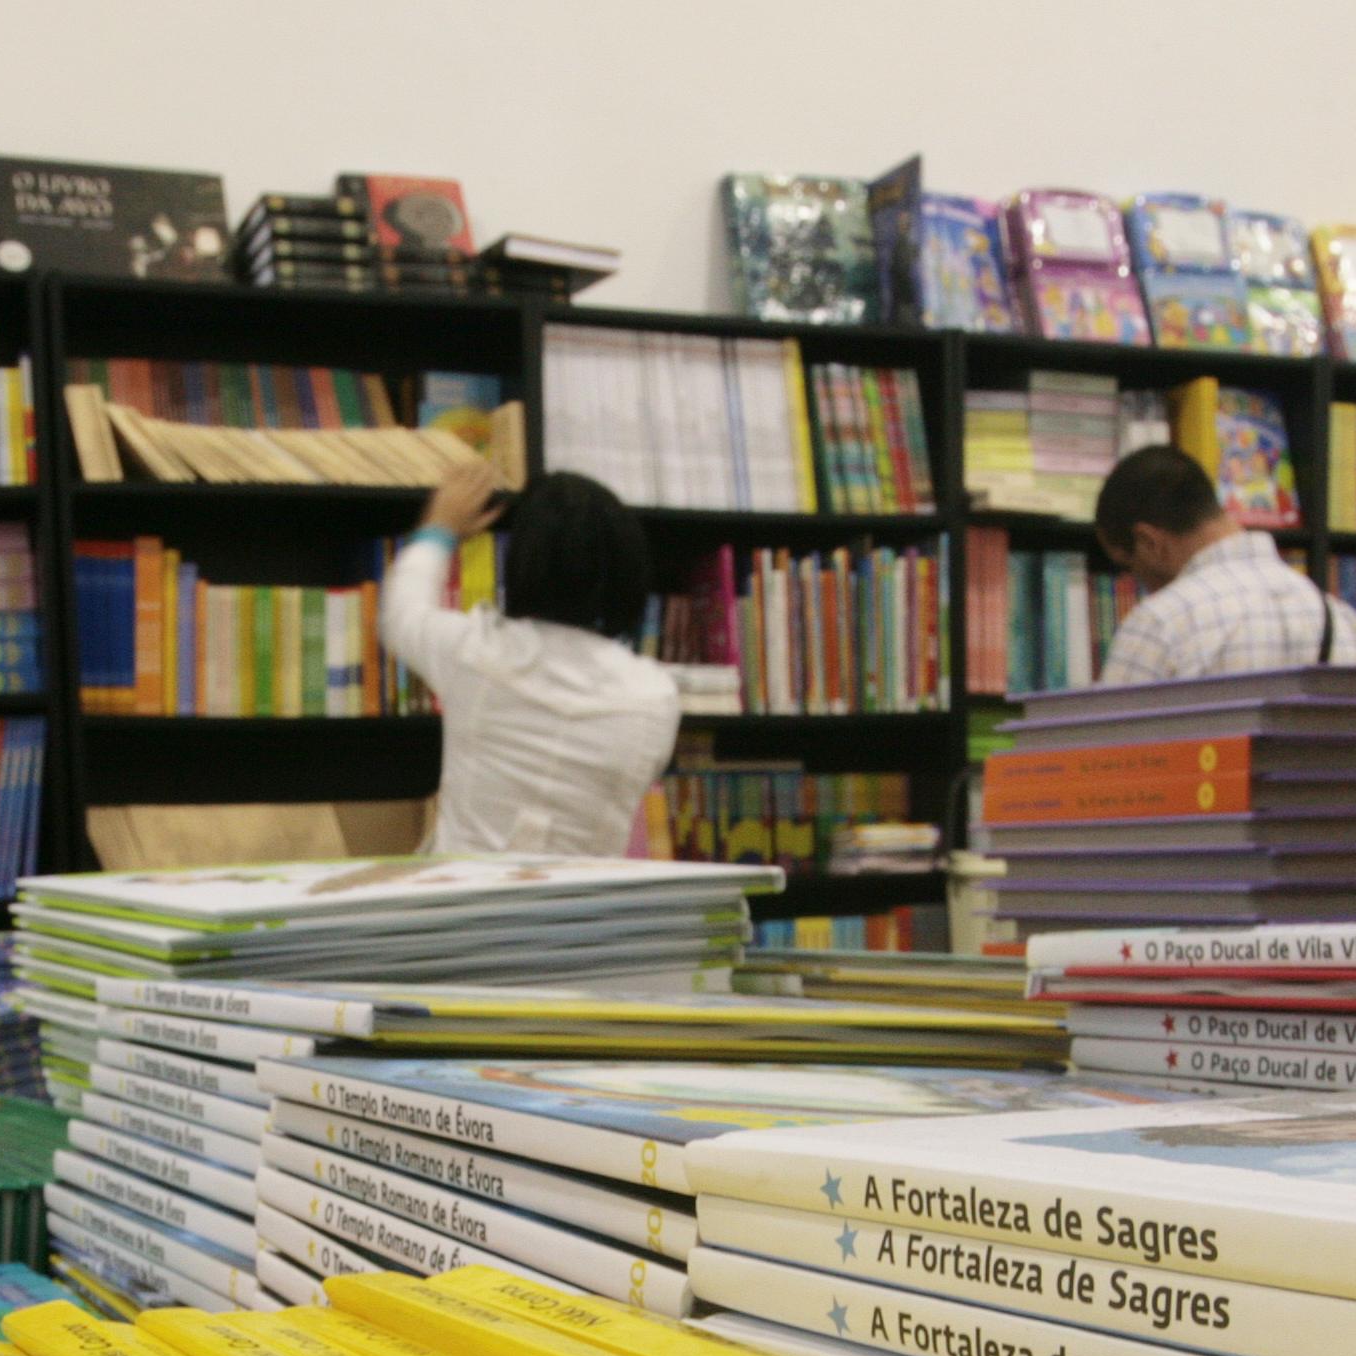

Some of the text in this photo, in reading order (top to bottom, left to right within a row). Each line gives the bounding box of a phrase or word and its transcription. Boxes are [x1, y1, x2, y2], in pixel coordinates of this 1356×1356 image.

[1144, 938, 1161, 963] O
[1165, 939, 1205, 969] Paço
[1212, 937, 1262, 963] Ducal
[1267, 937, 1291, 962] de
[1296, 935, 1334, 961] Vila
[1187, 1015, 1203, 1037] O
[1207, 1016, 1247, 1045] Paço
[1256, 1018, 1304, 1046] Ducal
[1313, 1021, 1338, 1047] de
[1190, 1050, 1206, 1074] O
[1210, 1052, 1248, 1082] Paço
[1257, 1055, 1305, 1082] Ducal
[1313, 1058, 1338, 1084] de
[327, 1083, 494, 1143] O Templo Romano de Évora
[341, 1127, 504, 1198] O Templo Romano de Évora
[329, 1163, 487, 1243] O Templo Romano de Évora
[863, 1174, 1220, 1264] A Fortaleza de Sagres
[325, 1202, 334, 1225] O
[337, 1206, 374, 1242] Templo
[378, 1222, 426, 1265] Romano
[430, 1243, 444, 1272] de
[877, 1229, 1232, 1331] A Fortaleza de Sagres
[870, 1305, 890, 1343] A
